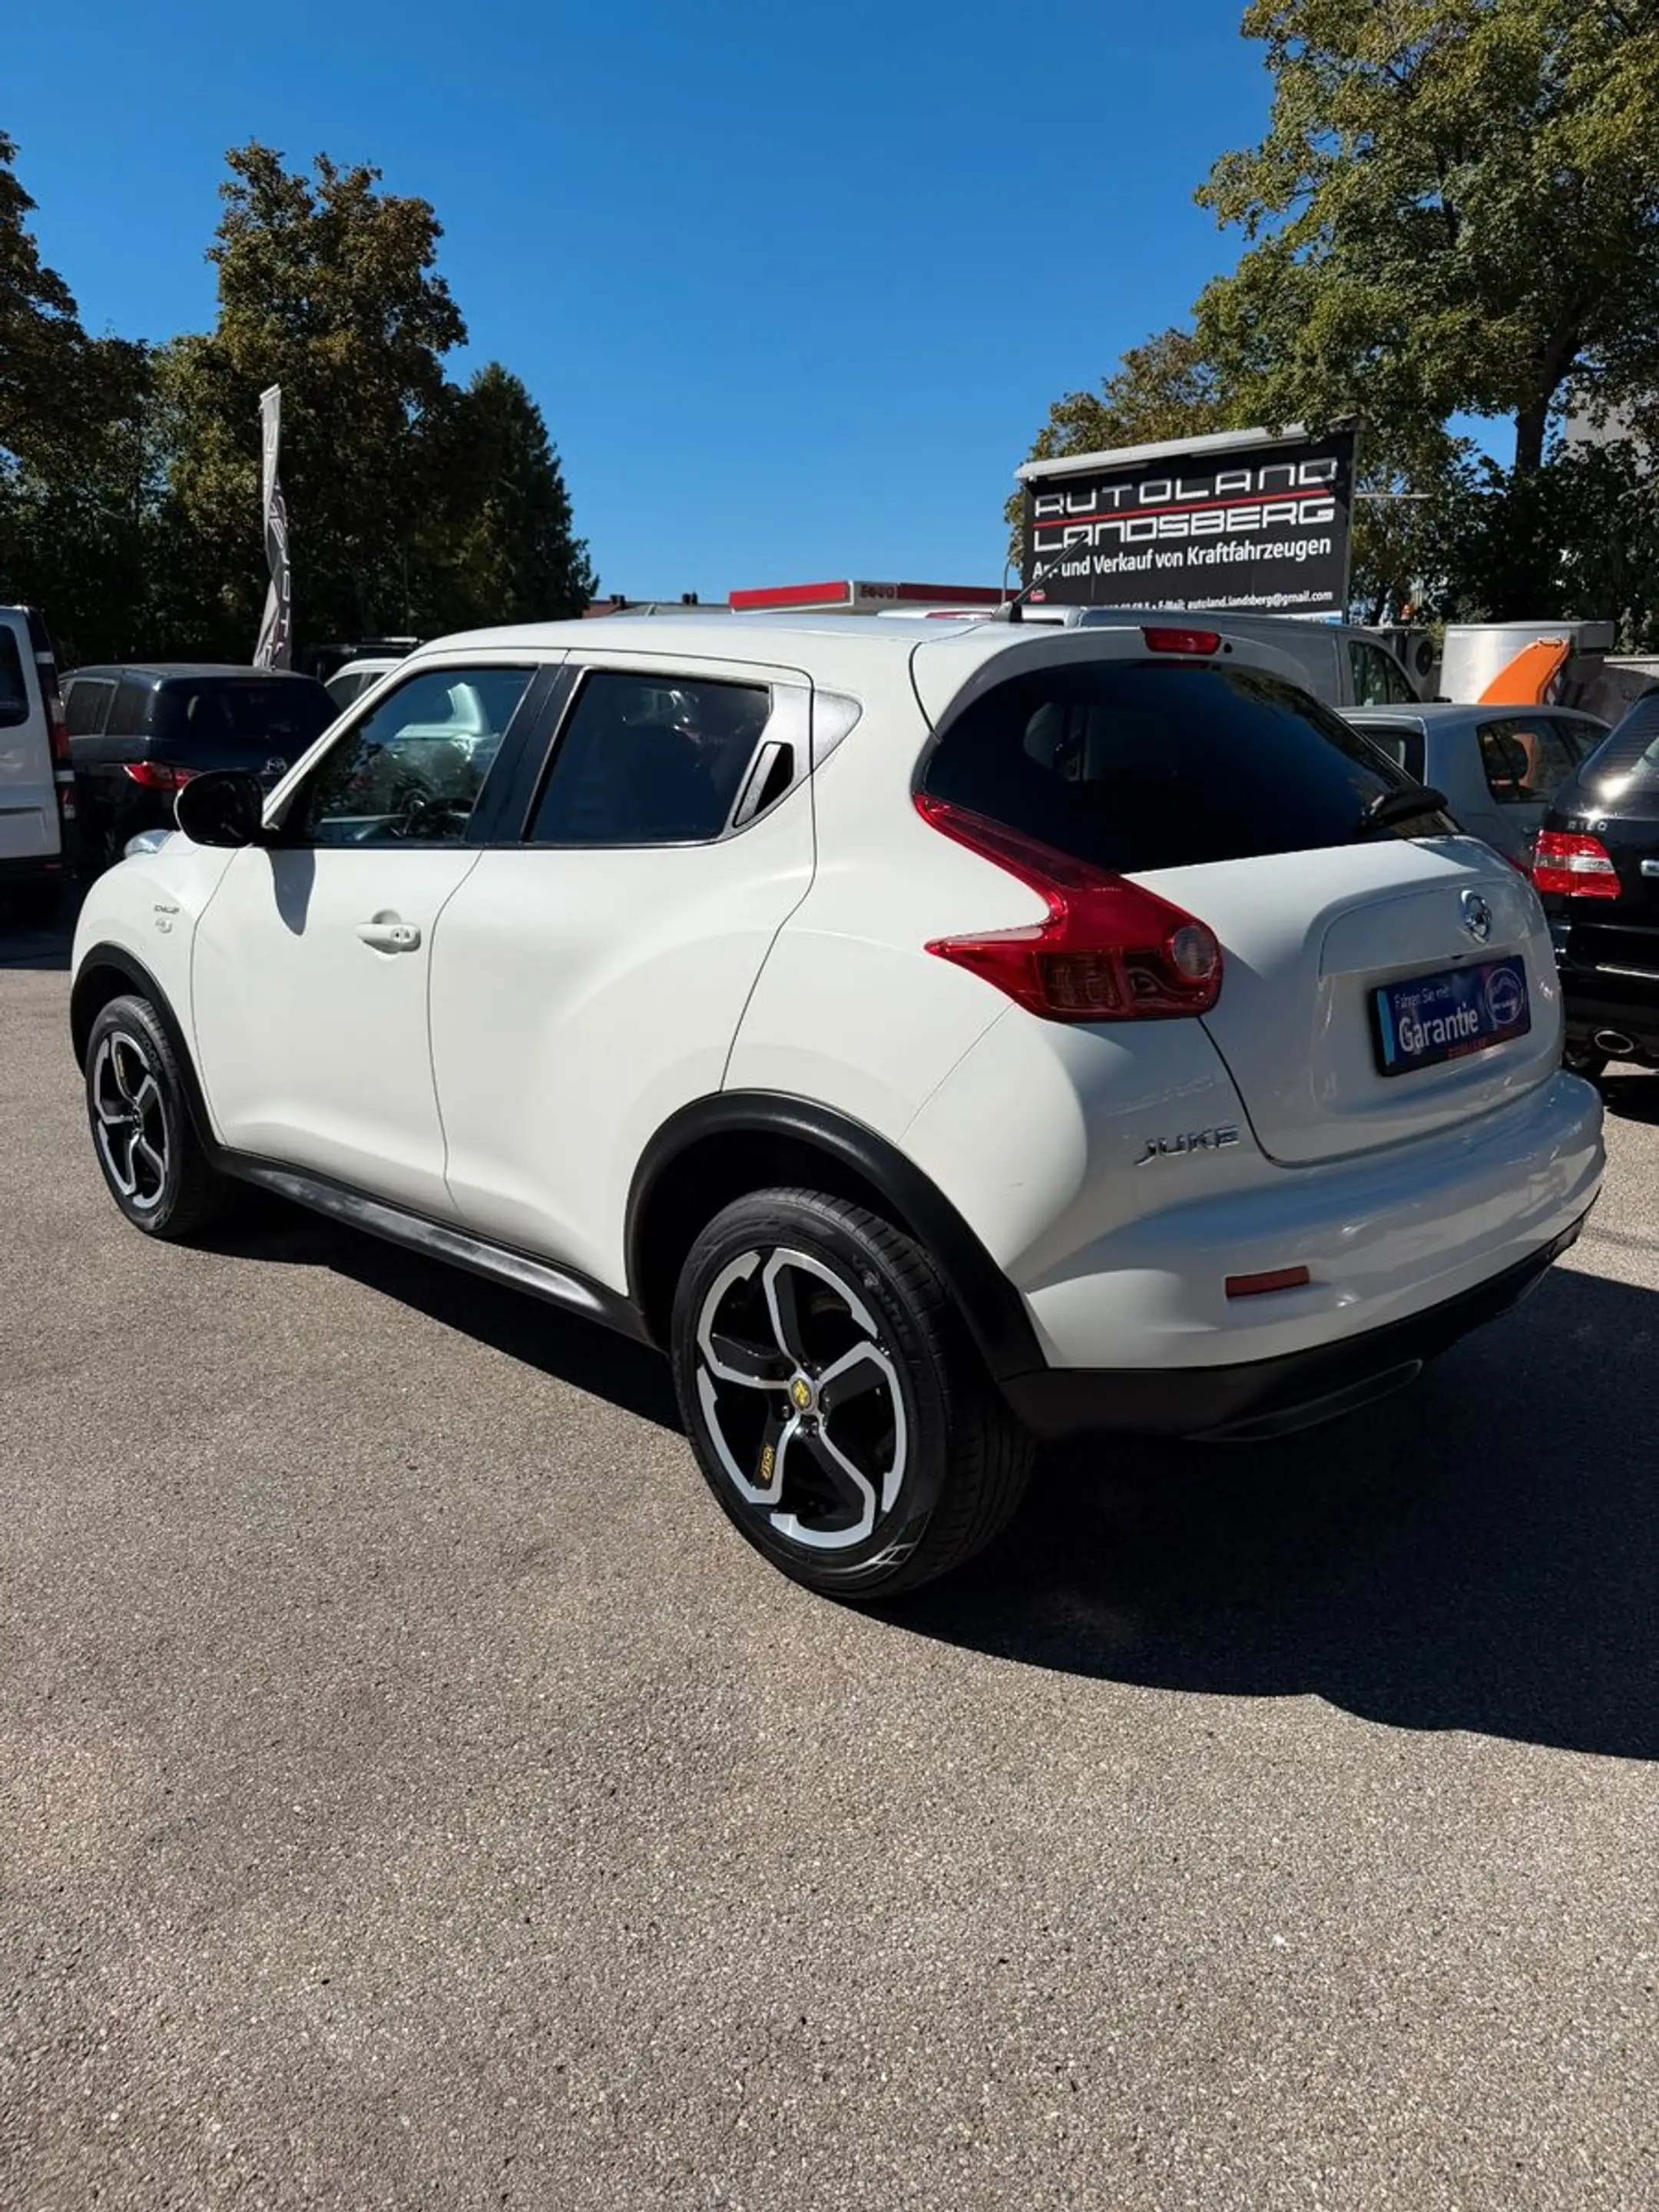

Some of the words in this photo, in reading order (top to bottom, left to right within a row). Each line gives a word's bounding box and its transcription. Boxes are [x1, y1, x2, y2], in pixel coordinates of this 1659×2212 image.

[1035, 457, 1338, 518] AUTOLAND
[1033, 497, 1336, 552] LANDSBERG
[1061, 555, 1091, 578] und
[1093, 548, 1154, 575] Verkauf
[1155, 551, 1184, 568] von
[1187, 538, 1332, 563] Kraftfahrzeugen
[1399, 1002, 1479, 1053] Garantie
[1134, 1124, 1240, 1167] JUKE
